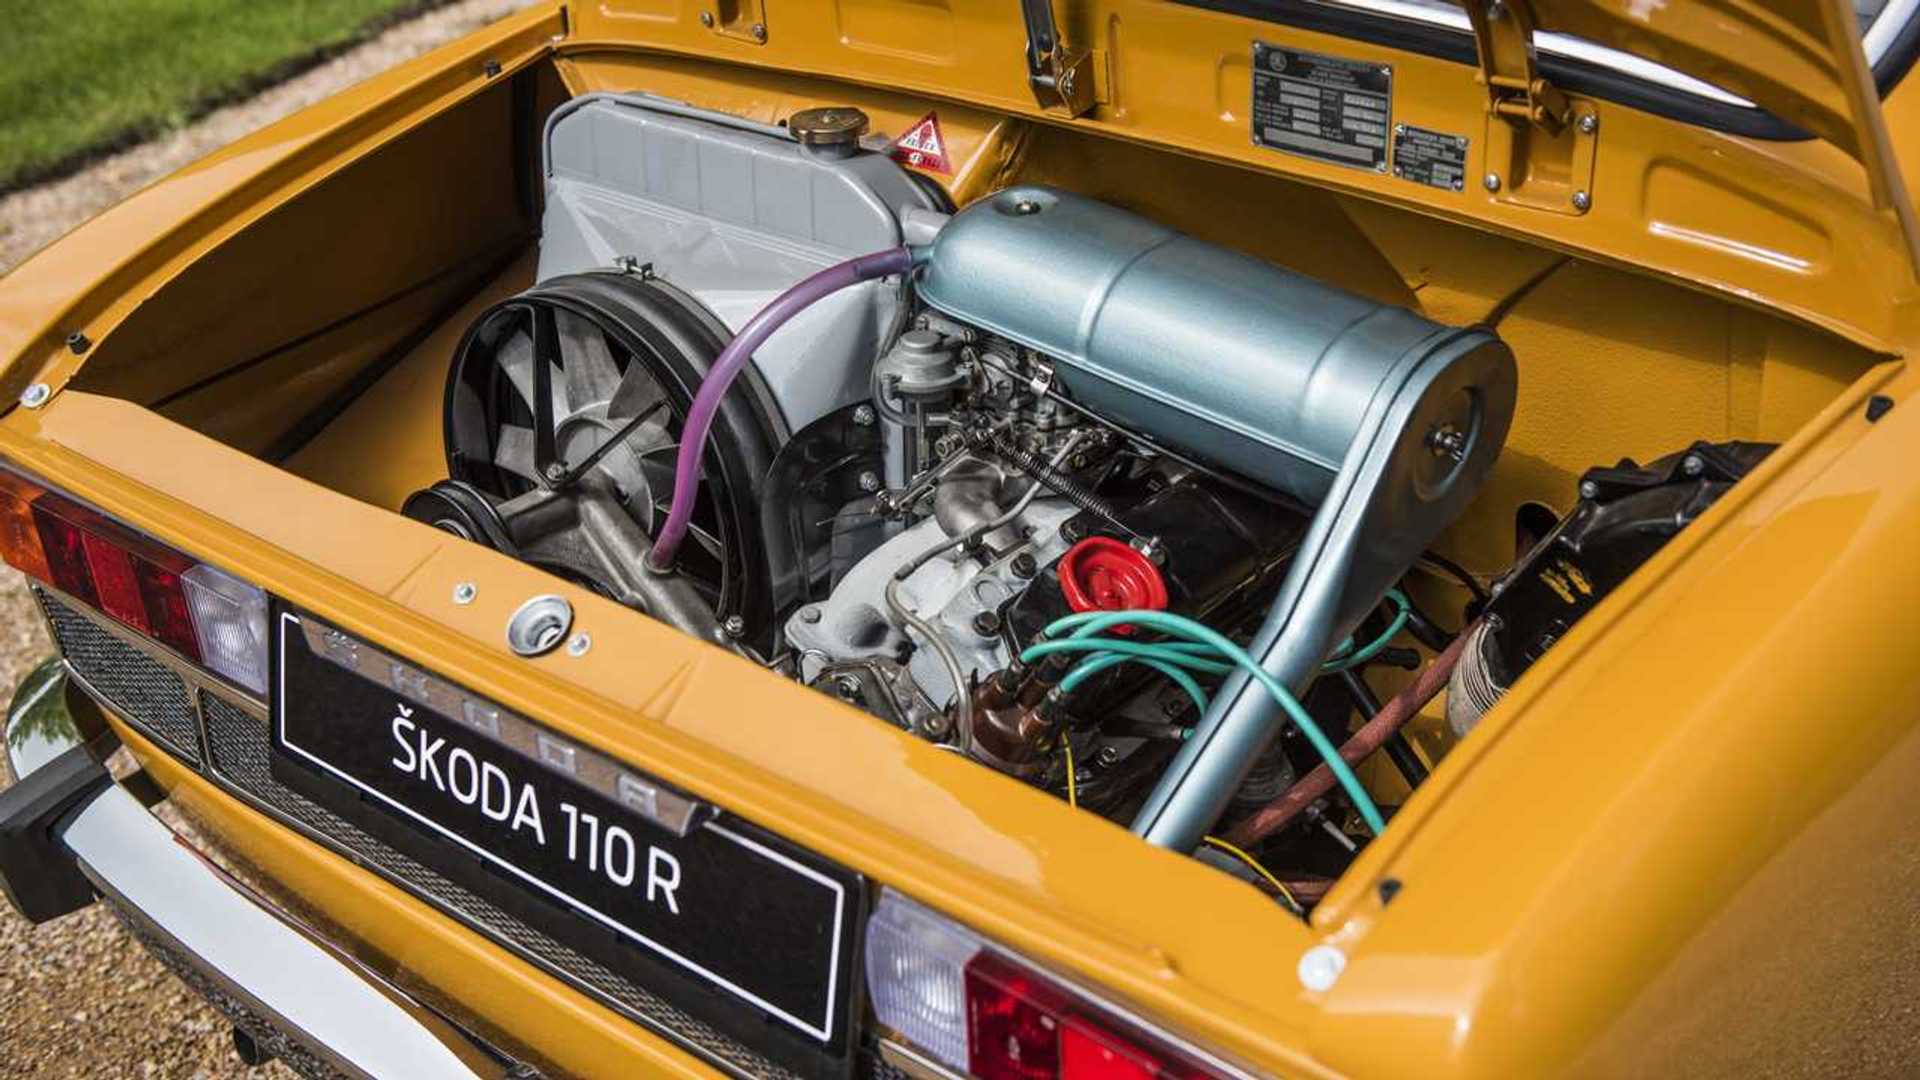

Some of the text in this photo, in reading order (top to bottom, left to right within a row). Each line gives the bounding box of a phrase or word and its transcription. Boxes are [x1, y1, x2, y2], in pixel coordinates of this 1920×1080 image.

[392, 703, 682, 915] ŠKODA 110 R
